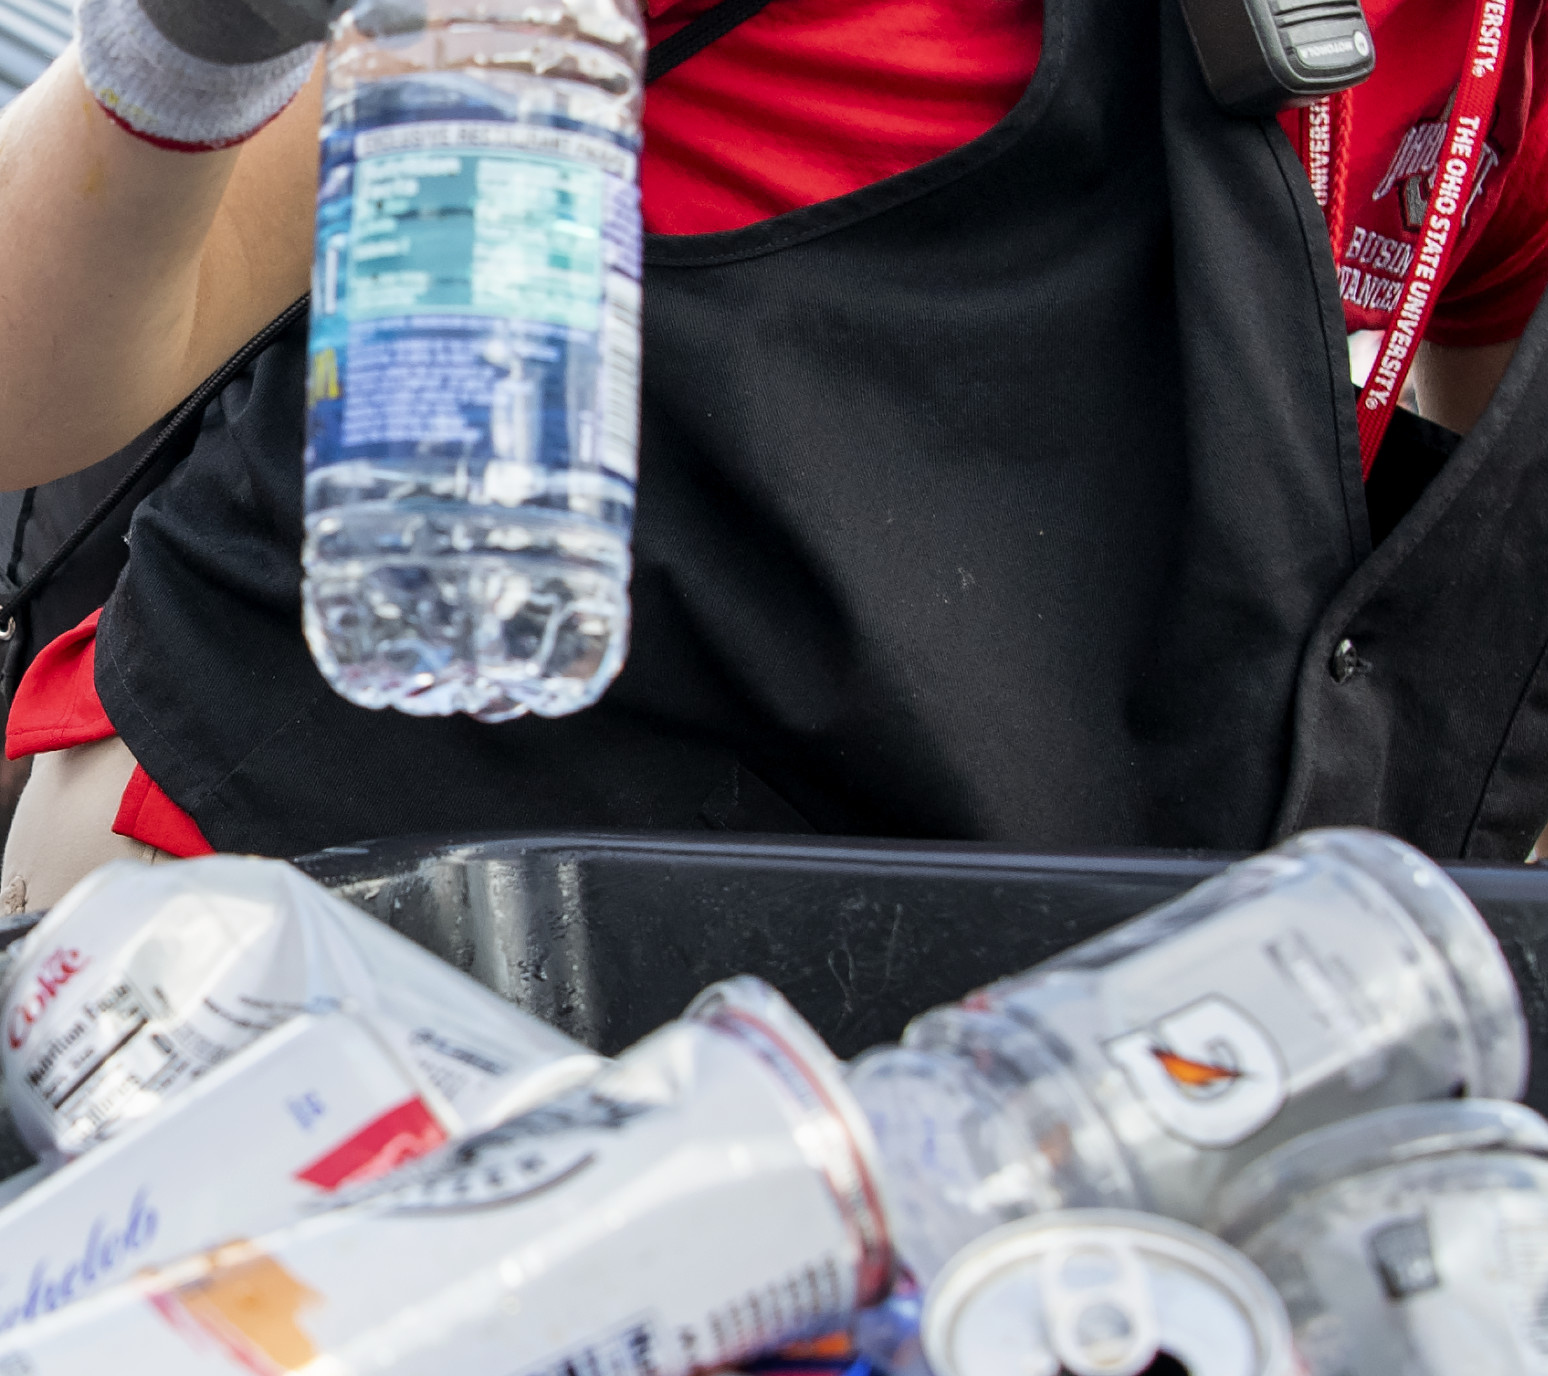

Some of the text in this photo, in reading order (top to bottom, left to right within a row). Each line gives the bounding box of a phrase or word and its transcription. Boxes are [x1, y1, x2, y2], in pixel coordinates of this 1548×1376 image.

[1451, 115, 1481, 158] THE
[1434, 158, 1468, 216] OHIO
[1414, 214, 1451, 281] STATE
[6, 945, 93, 1050] Coke
[24, 1020, 87, 1087] Nutrition
